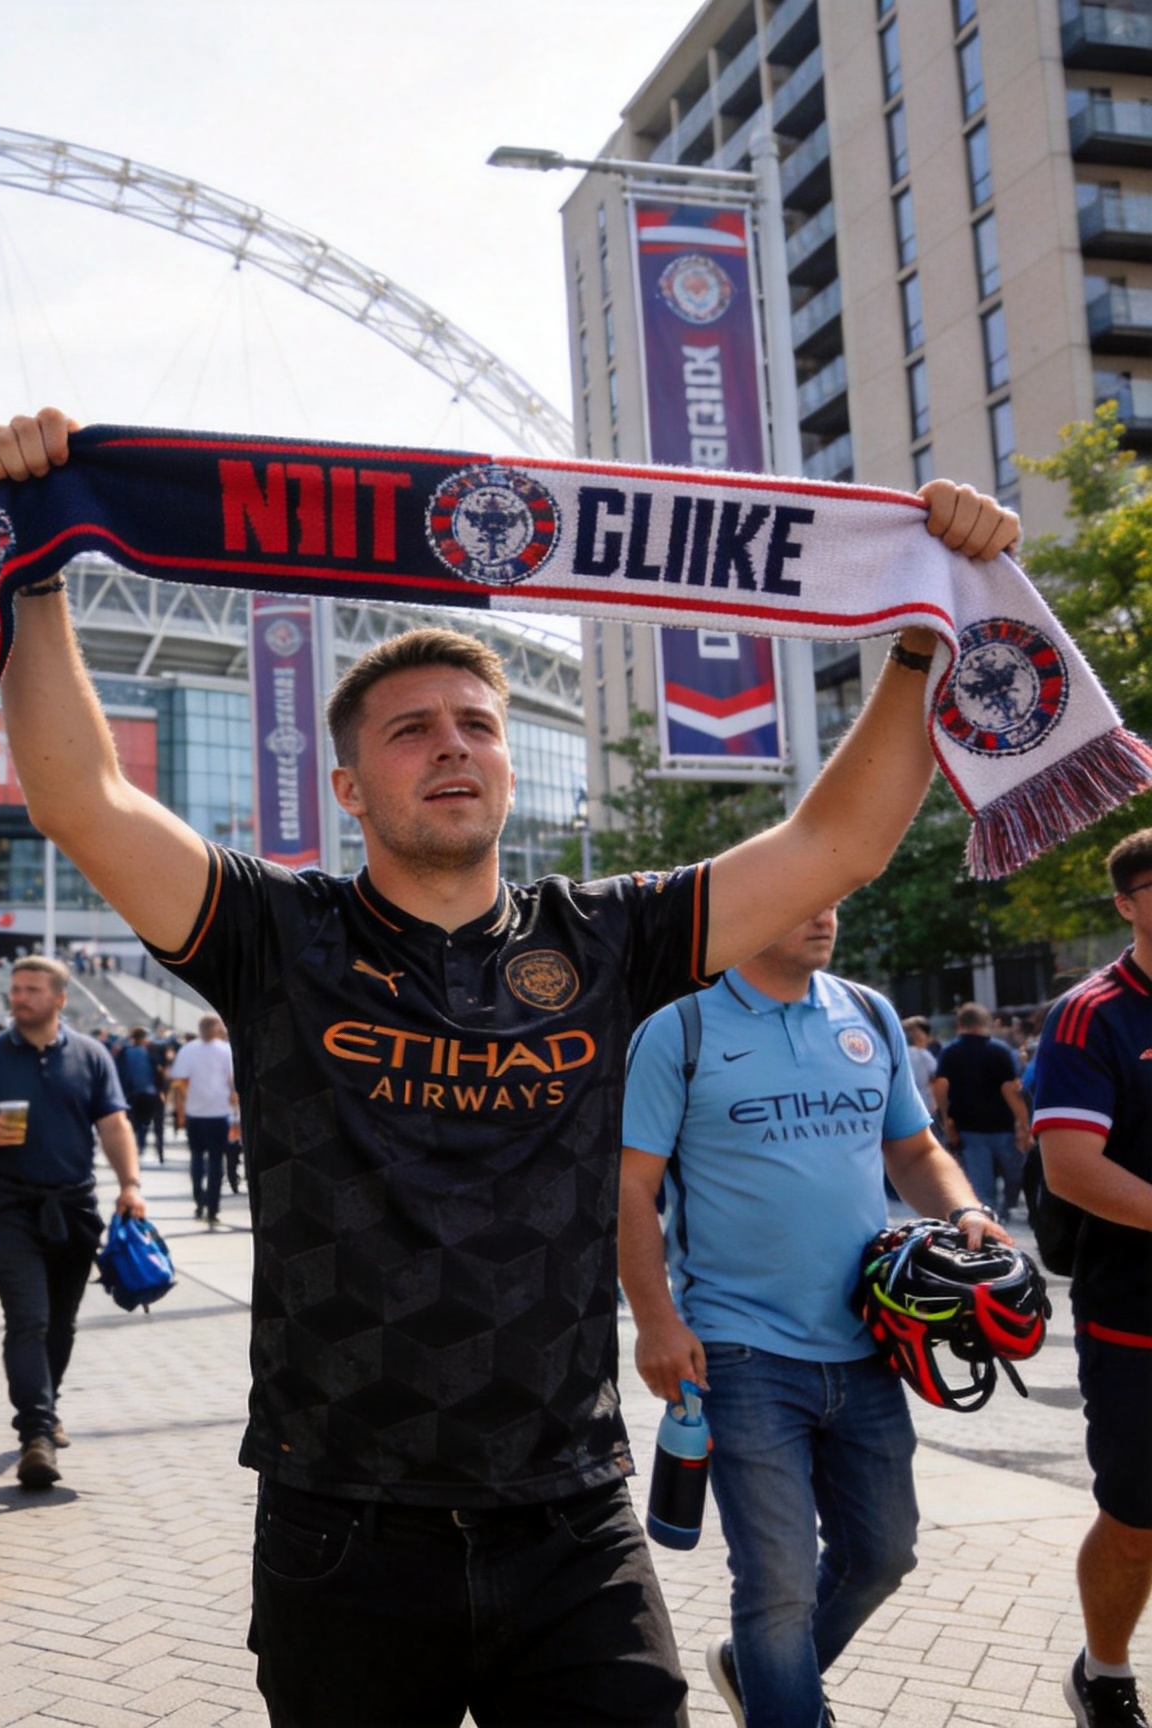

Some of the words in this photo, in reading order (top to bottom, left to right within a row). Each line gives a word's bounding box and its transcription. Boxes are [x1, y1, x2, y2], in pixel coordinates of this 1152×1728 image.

[323, 1021, 597, 1077] ETIHAD
[368, 1076, 566, 1112] AIRWAYS
[729, 1088, 884, 1124] ETIHAD
